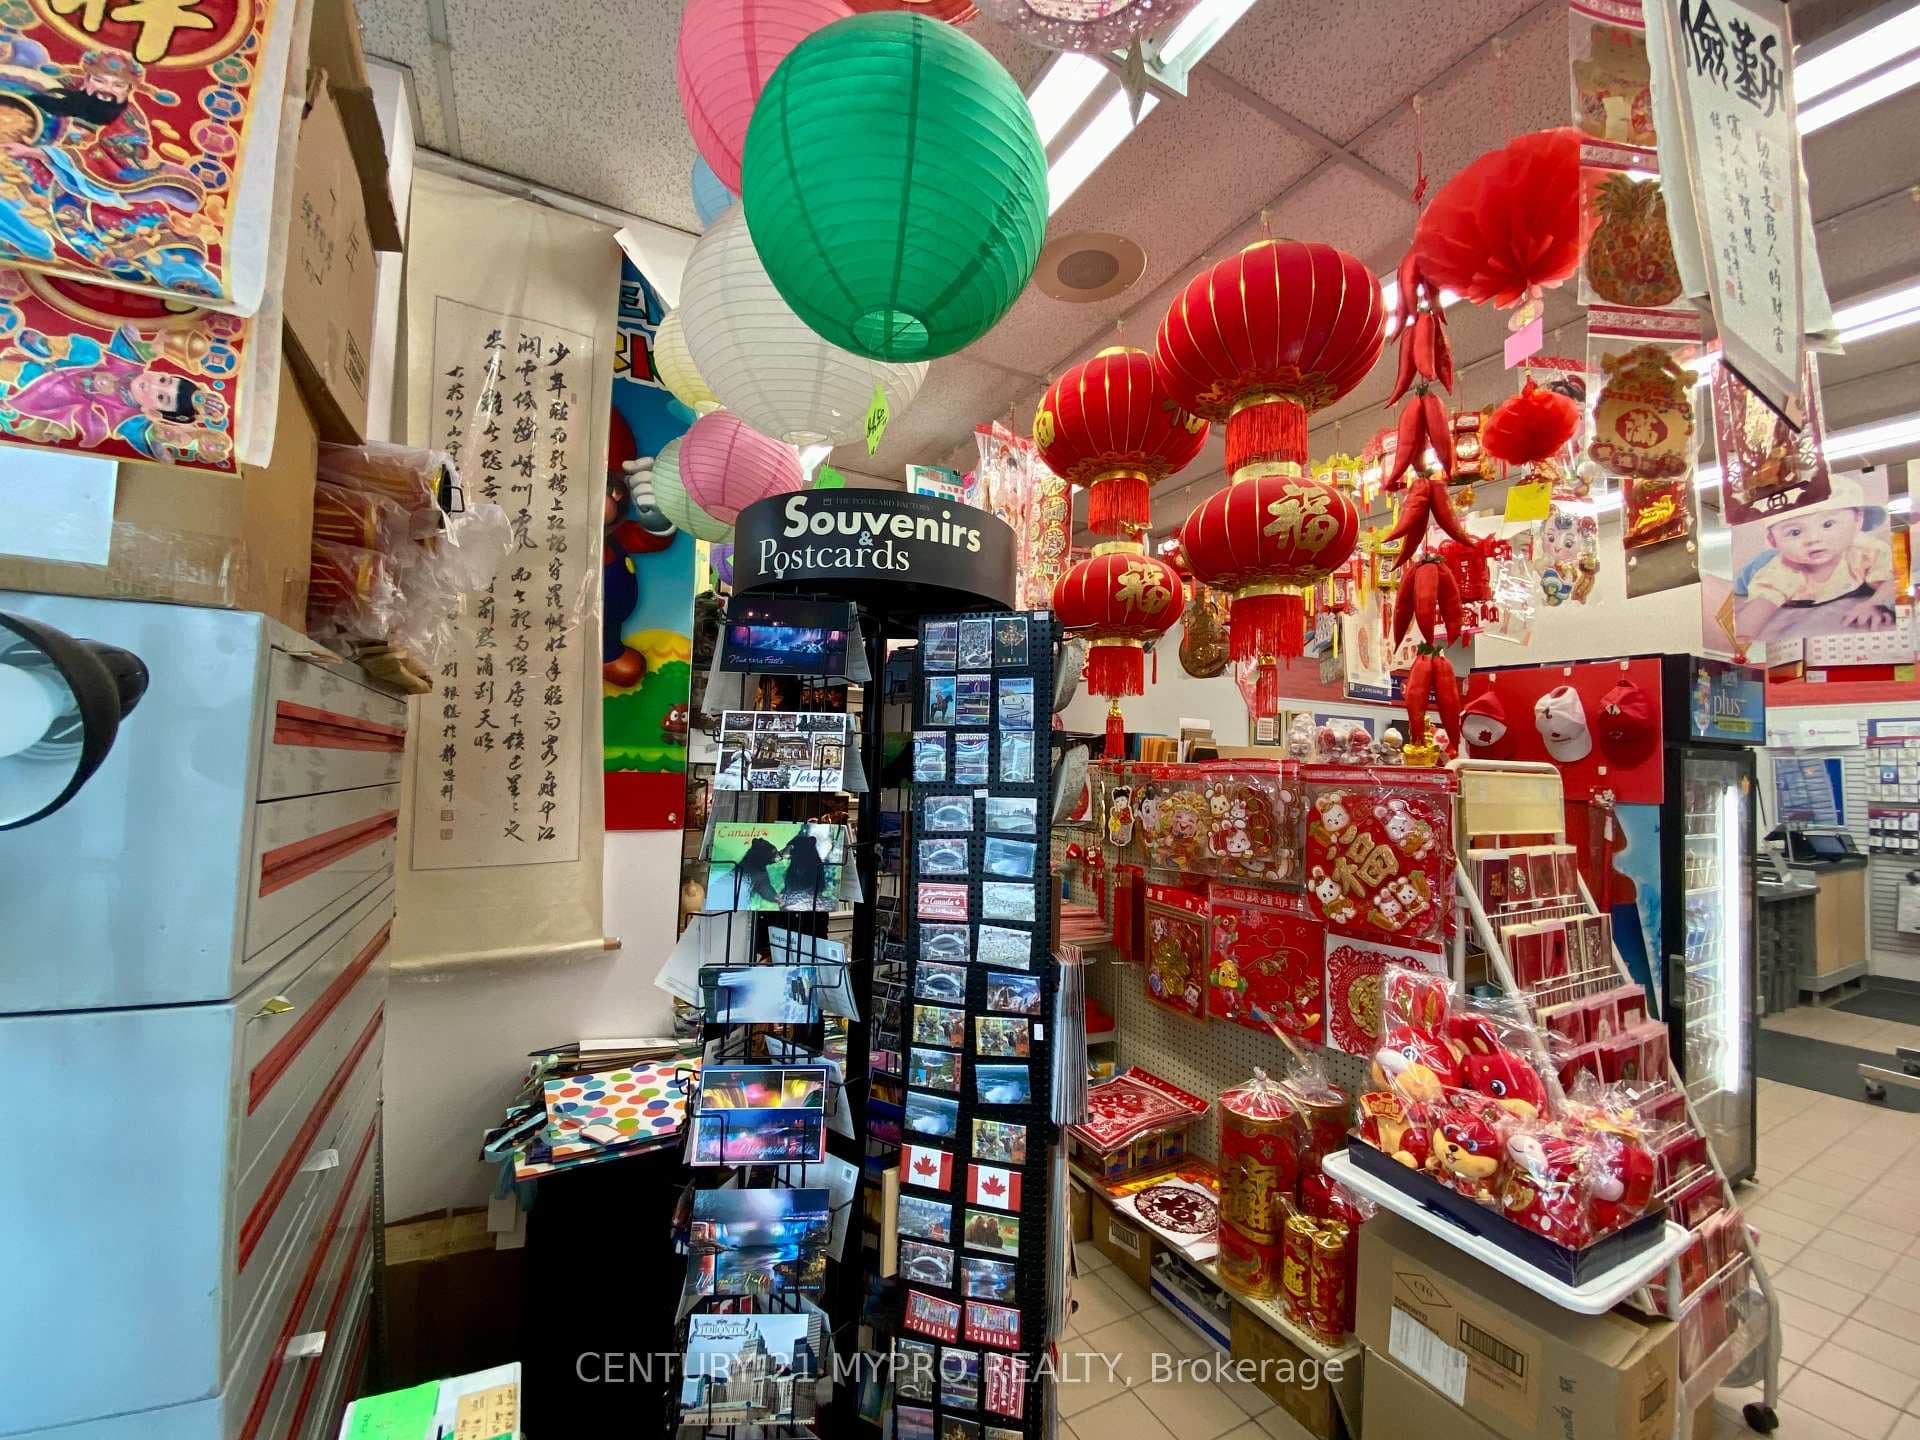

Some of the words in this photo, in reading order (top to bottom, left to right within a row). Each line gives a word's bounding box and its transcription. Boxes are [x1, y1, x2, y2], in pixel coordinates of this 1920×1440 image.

[1625, 411, 1659, 446] 福
[852, 497, 895, 508] POSTCARD
[1263, 484, 1342, 553] 福
[783, 495, 981, 552] Souvenirs
[858, 531, 874, 546] &
[758, 538, 910, 577] Postcards
[1115, 561, 1171, 613] 福
[1713, 688, 1740, 722] plus
[717, 825, 763, 841] Canada
[912, 1320, 949, 1339] CANADA
[973, 1331, 1010, 1346] CANADA
